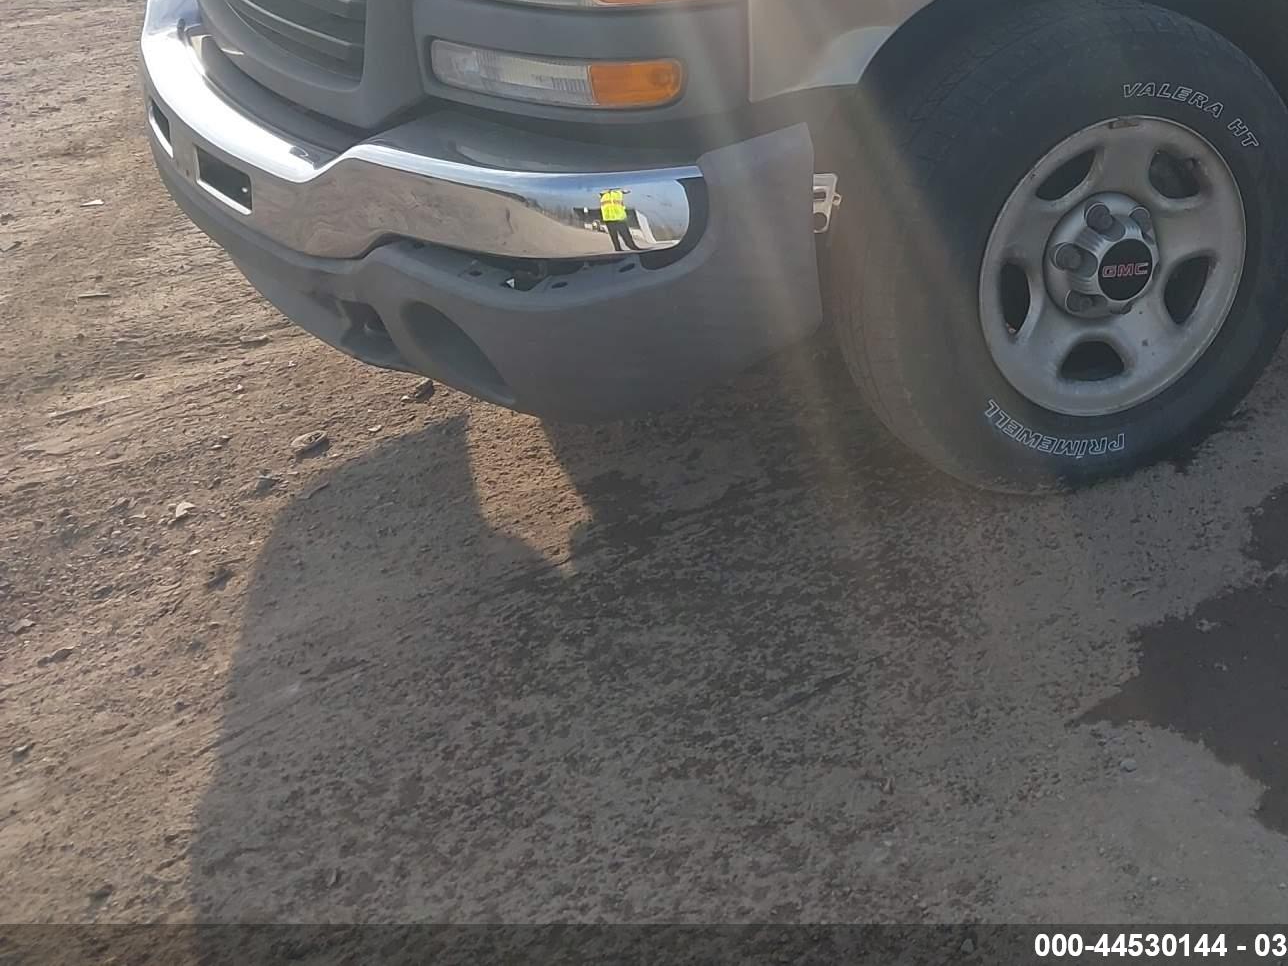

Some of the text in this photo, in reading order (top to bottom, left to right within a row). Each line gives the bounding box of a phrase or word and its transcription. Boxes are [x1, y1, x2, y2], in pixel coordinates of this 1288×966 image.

[1122, 82, 1259, 149] VALERA HT
[1102, 261, 1149, 278] GMC
[984, 399, 1126, 459] PRIMEWELL
